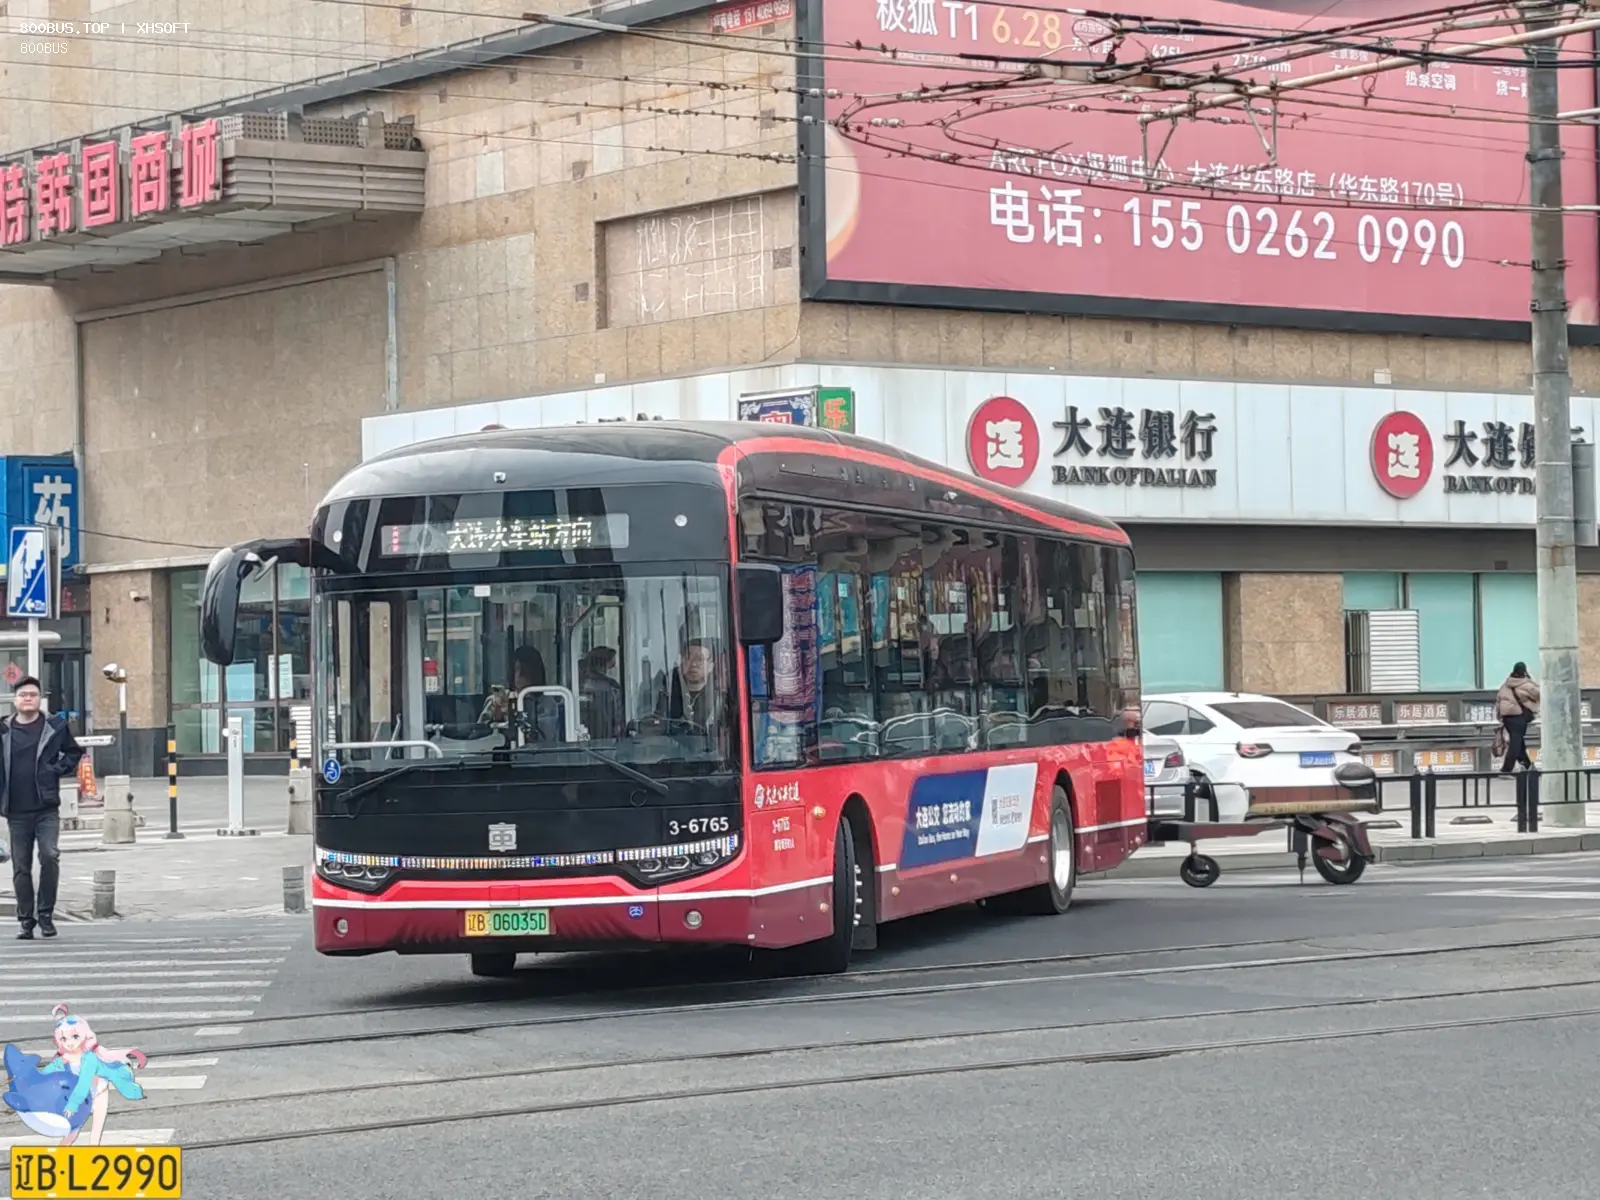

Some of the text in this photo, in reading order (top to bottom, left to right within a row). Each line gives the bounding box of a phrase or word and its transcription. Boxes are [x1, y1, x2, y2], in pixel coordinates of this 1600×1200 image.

[991, 8, 1062, 50] 6.28
[1123, 197, 1204, 251] 155
[1225, 204, 1337, 260] 0262
[1357, 214, 1465, 269] 0990
[1052, 405, 1218, 462] 大连银行
[1400, 703, 1447, 718] 乐居酒店
[669, 817, 730, 836] 3-6765
